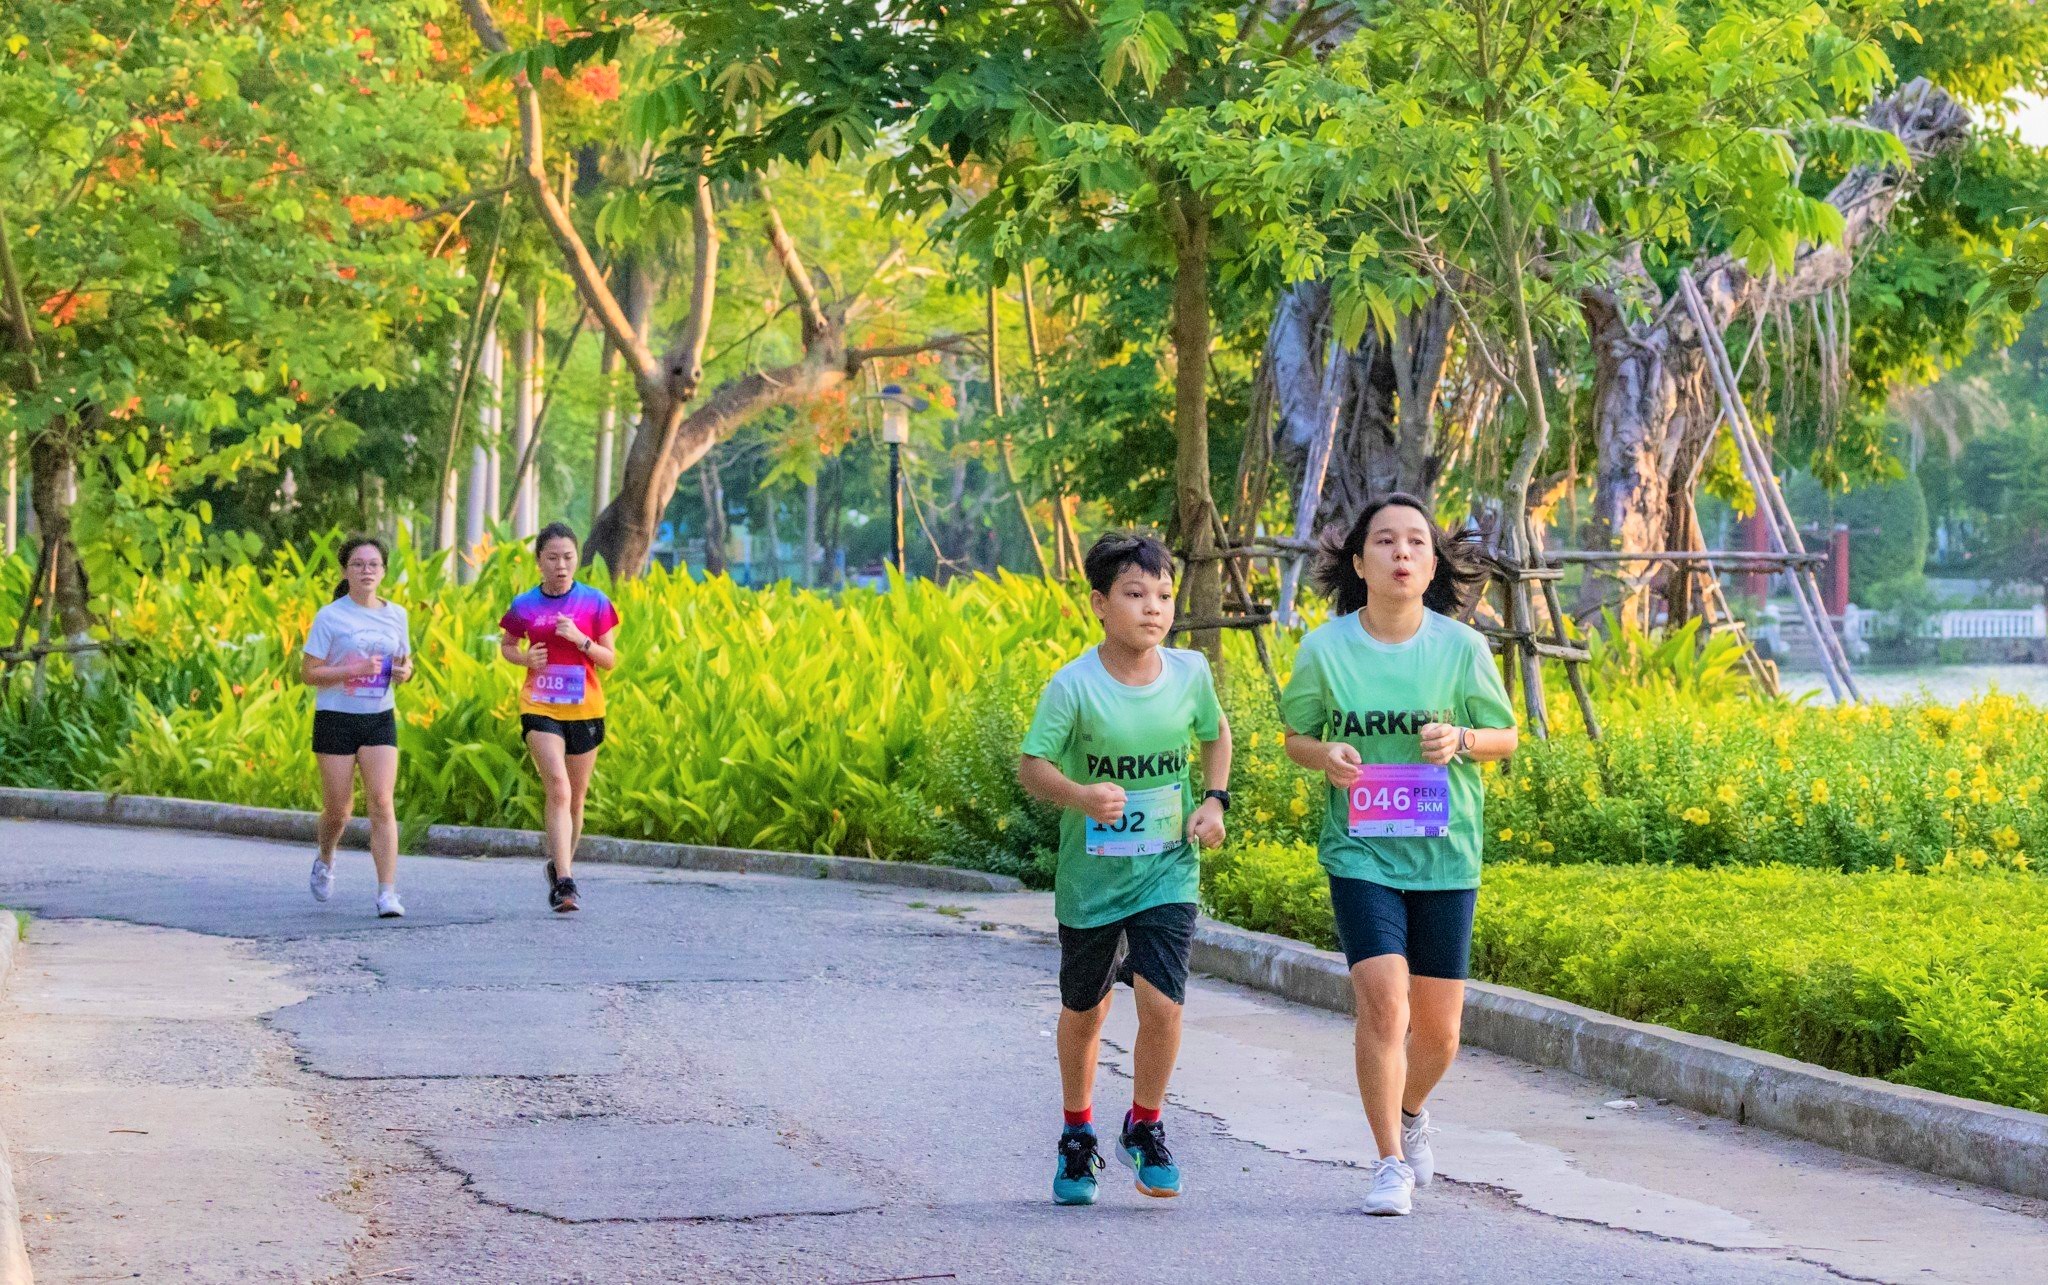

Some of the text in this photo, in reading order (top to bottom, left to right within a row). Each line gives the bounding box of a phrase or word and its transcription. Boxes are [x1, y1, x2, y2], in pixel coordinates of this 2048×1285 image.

[536, 676, 564, 690] 018
[1332, 708, 1456, 738] PARKR
[1353, 786, 1411, 812] 046
[1413, 787, 1447, 798] PEN 2
[1417, 801, 1443, 813] 5KM
